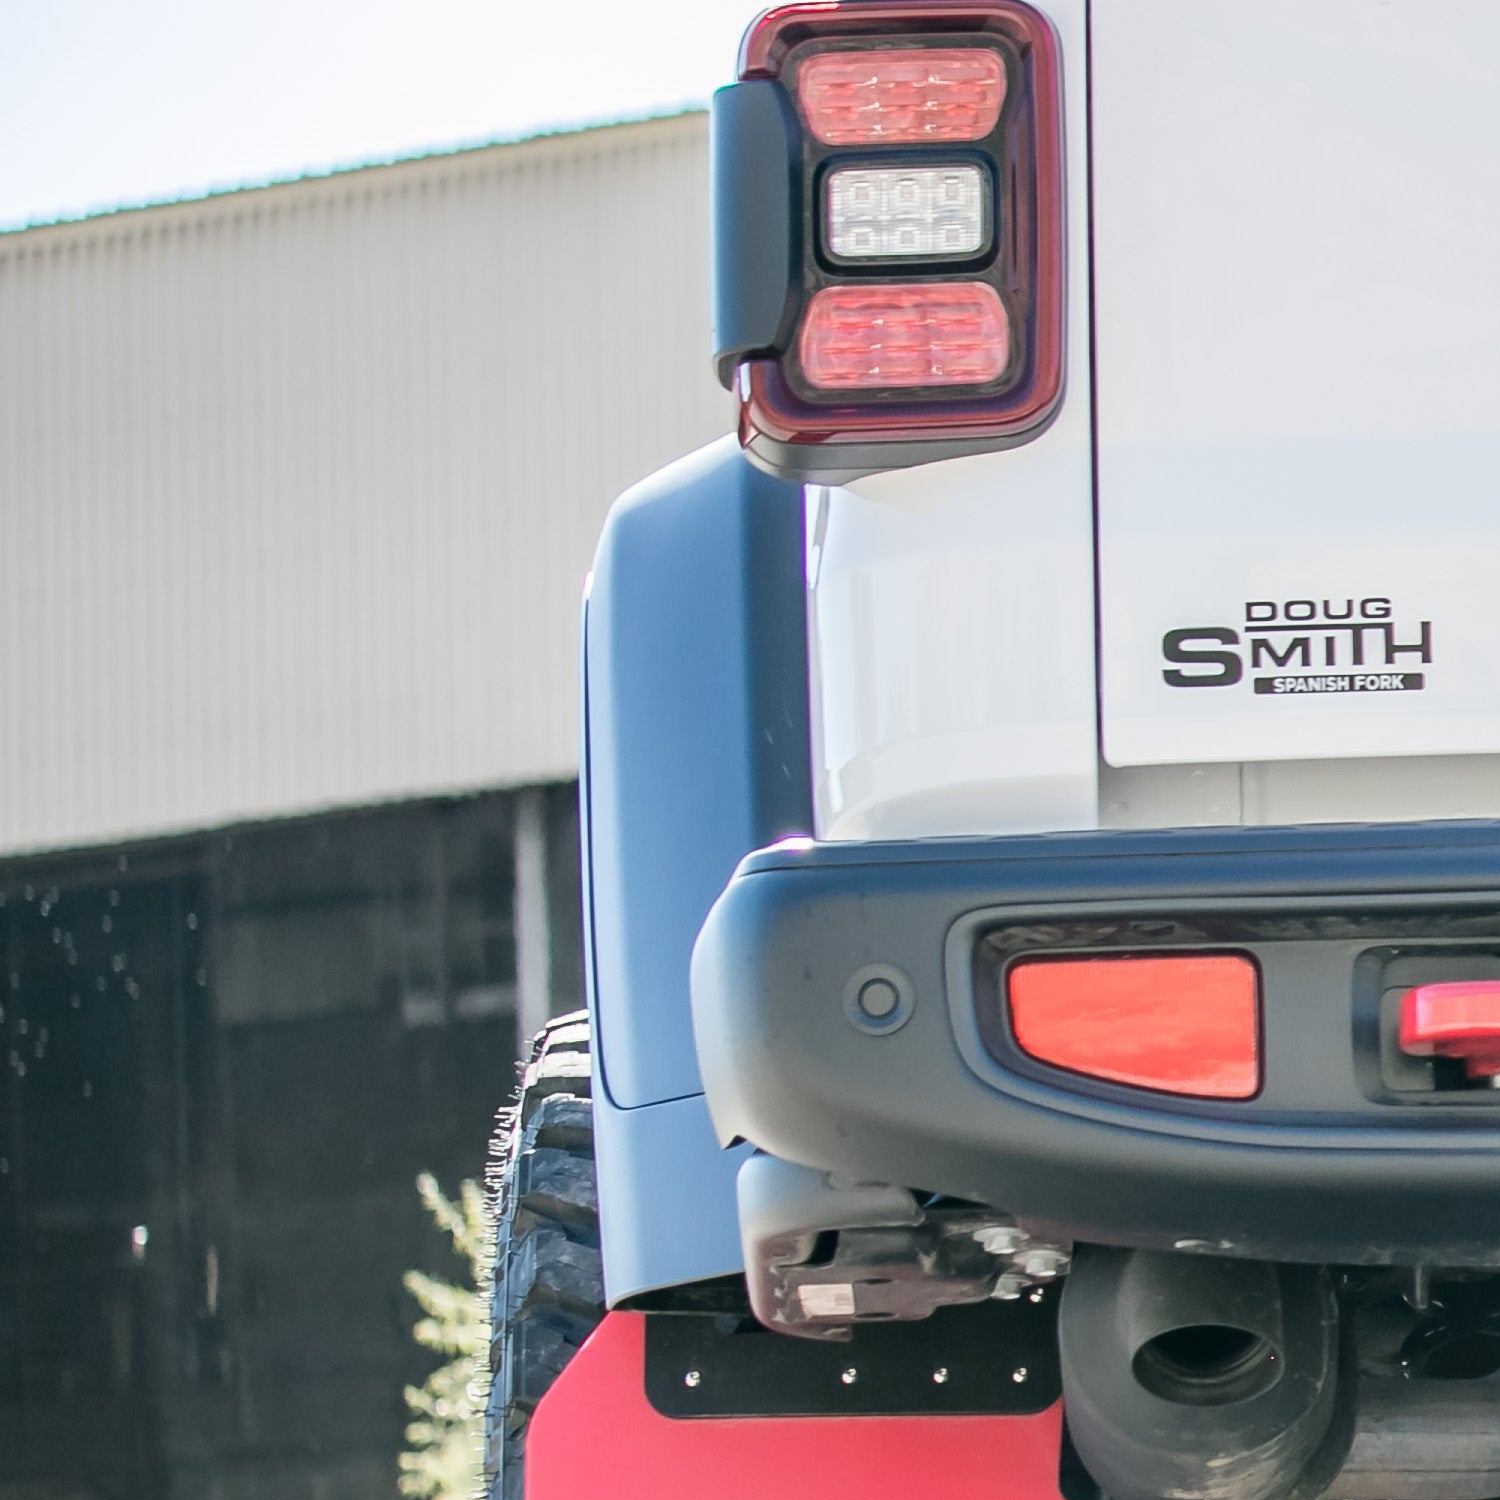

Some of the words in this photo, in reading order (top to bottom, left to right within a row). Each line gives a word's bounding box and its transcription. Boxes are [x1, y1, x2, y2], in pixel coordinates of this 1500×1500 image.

[1244, 597, 1393, 622] DOUG
[1161, 620, 1434, 688] SMITH
[1272, 674, 1351, 693] SPANISH
[1353, 672, 1405, 691] FORK
